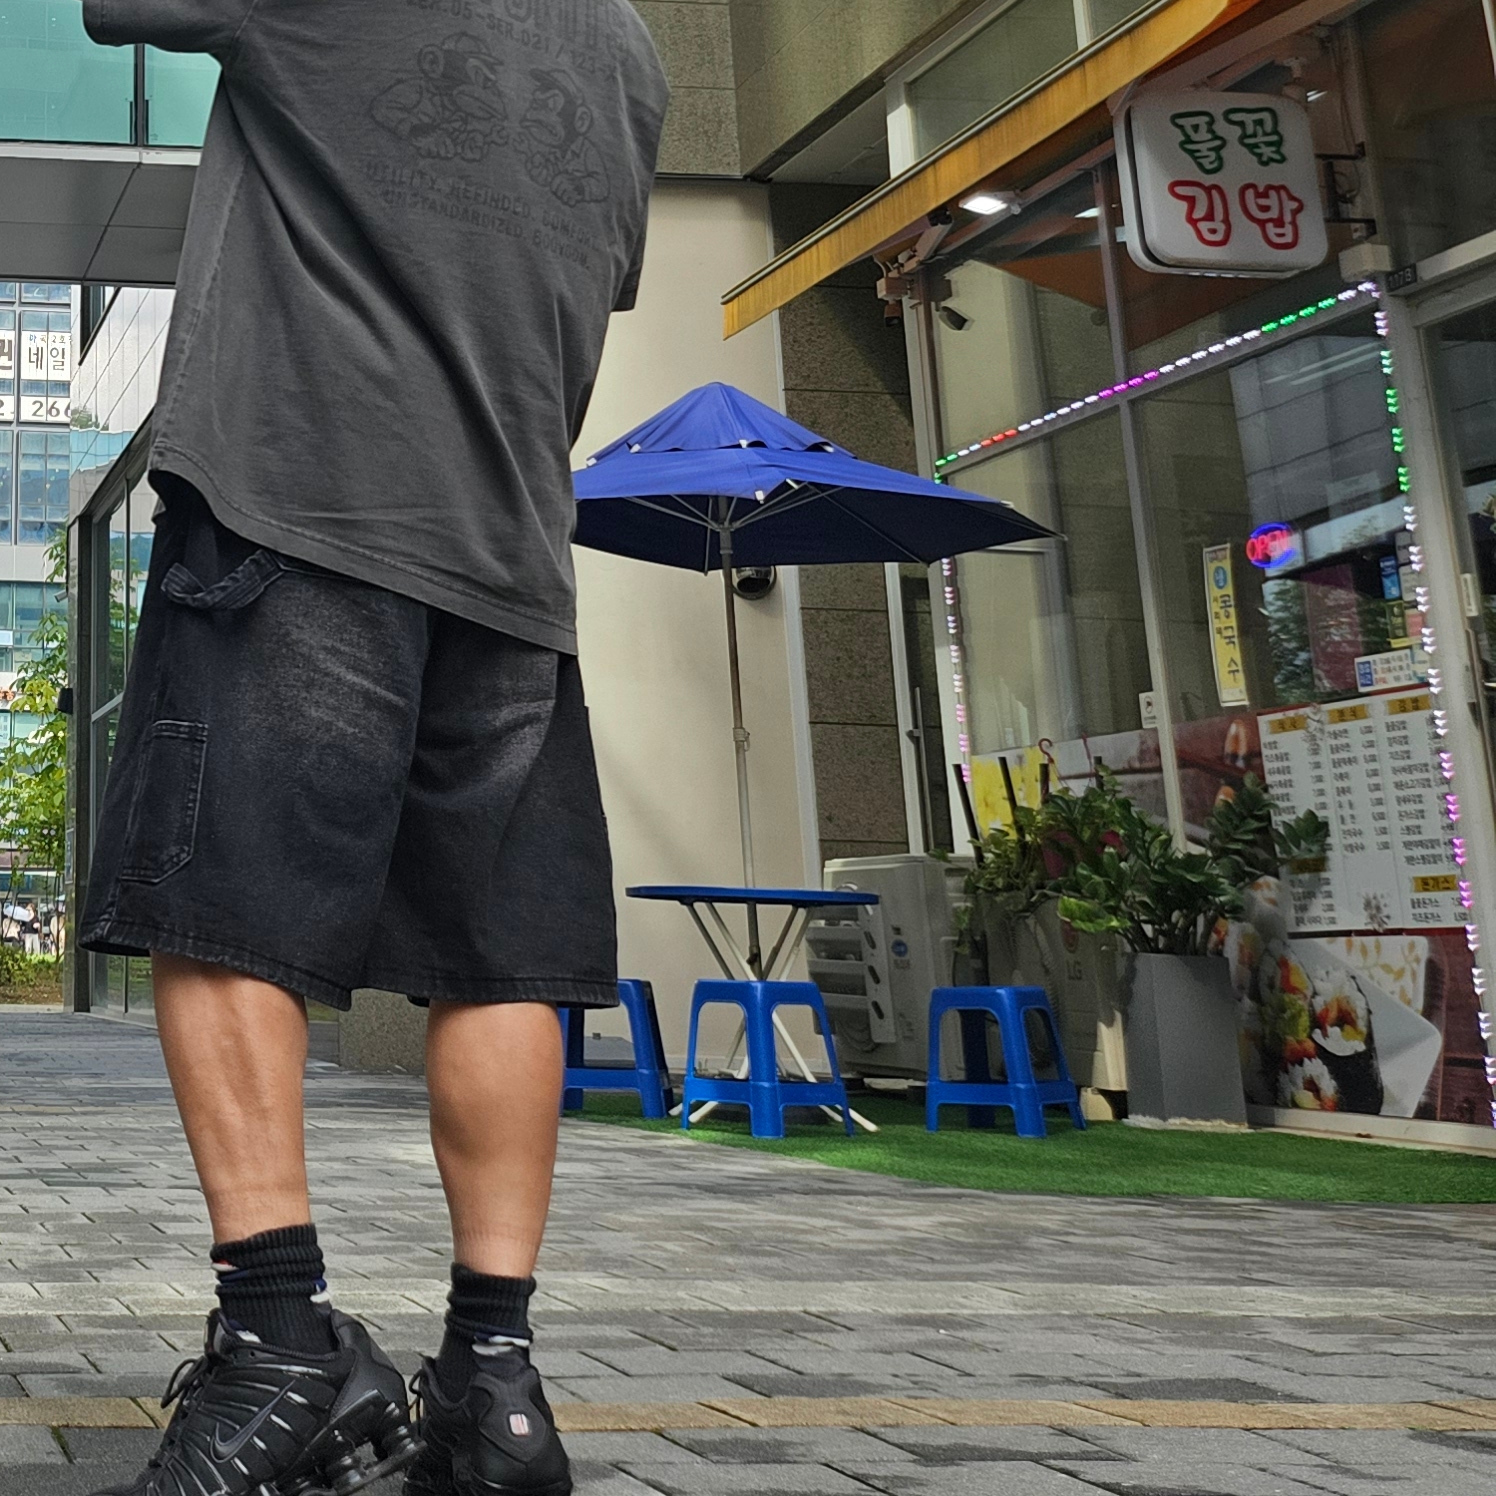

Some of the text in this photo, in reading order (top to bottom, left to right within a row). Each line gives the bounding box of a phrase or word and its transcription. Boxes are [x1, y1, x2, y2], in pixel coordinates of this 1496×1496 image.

[1169, 106, 1287, 175] 풀꽃
[1167, 179, 1304, 251] 김밥
[28, 346, 65, 371] 네일
[1246, 530, 1289, 562] OPEN
[1065, 960, 1082, 981] LG
